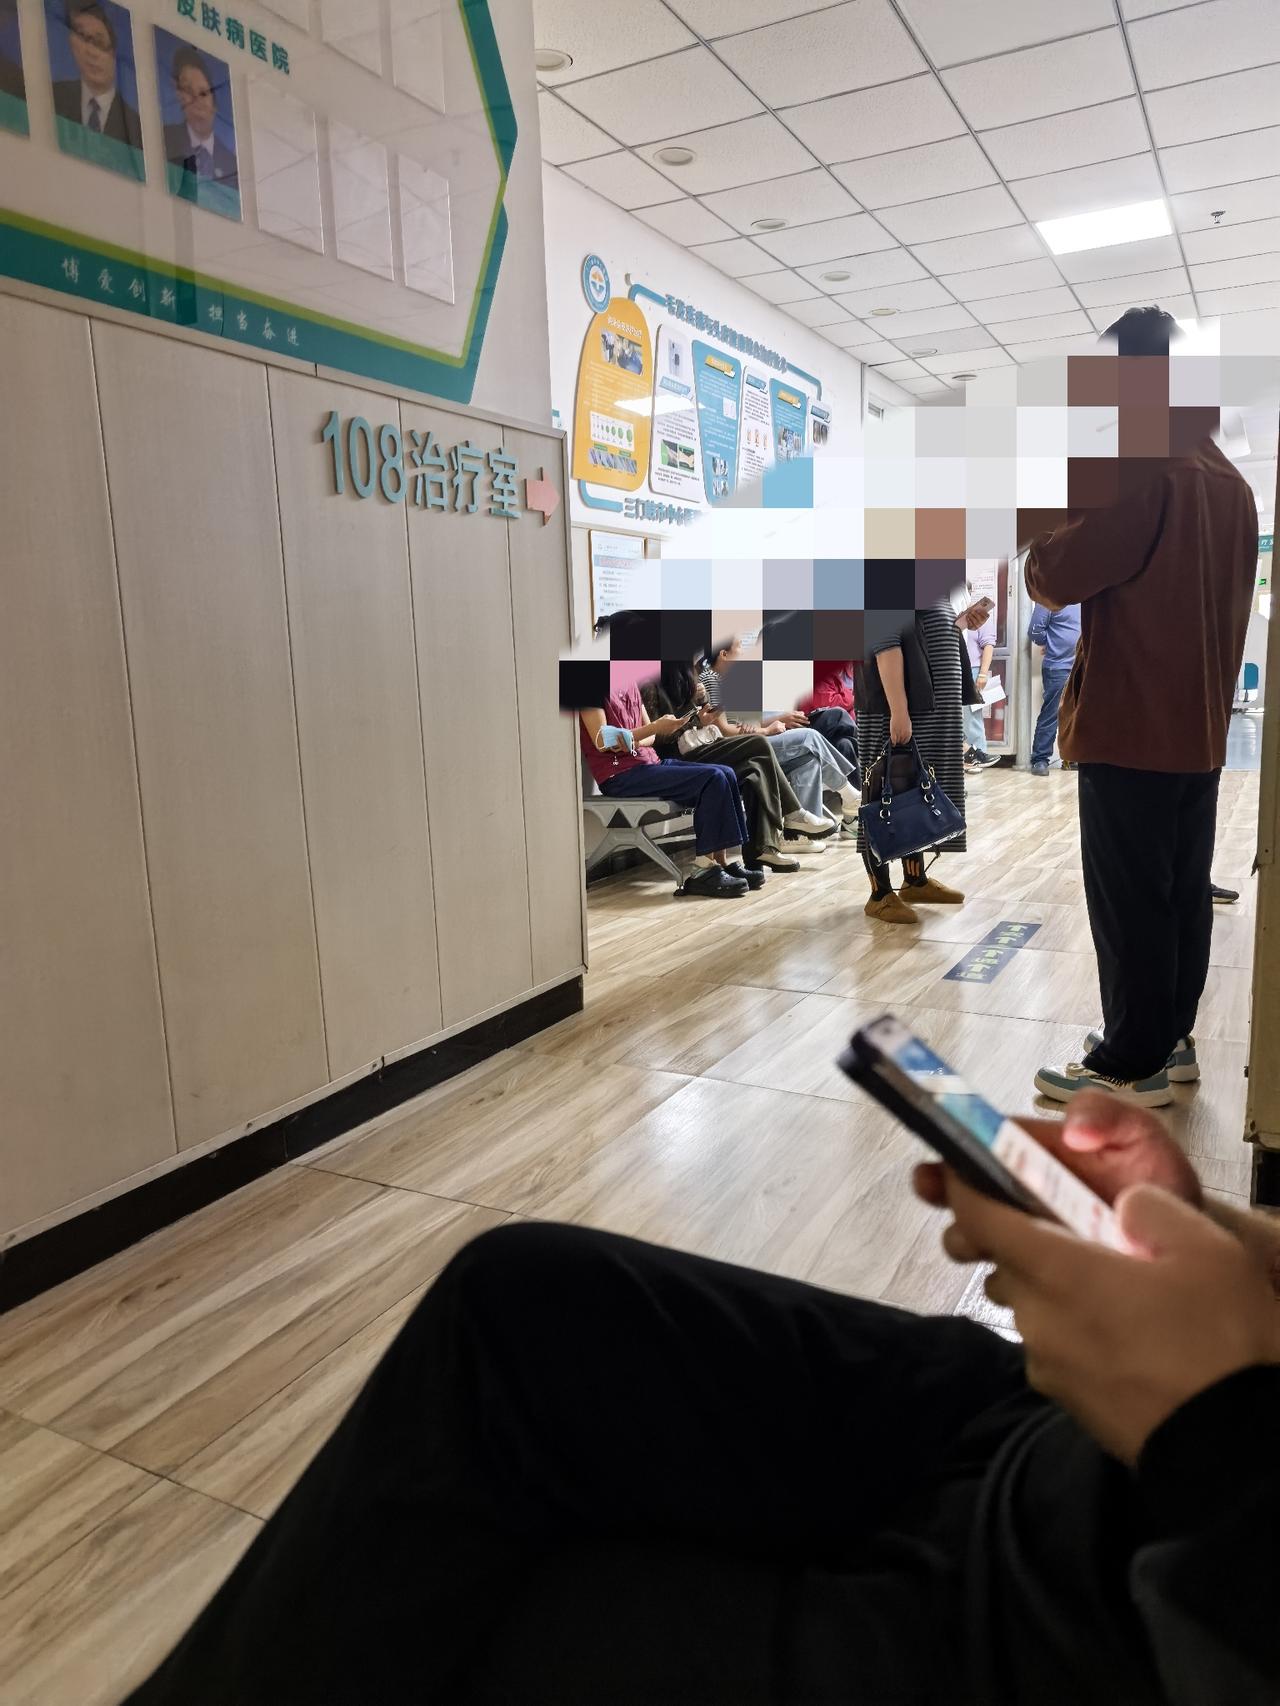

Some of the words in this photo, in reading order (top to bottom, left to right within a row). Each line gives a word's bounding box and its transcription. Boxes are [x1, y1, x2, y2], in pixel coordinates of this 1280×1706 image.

[177, 0, 290, 75] 皮肤病医院
[321, 410, 521, 519] 108治疗室
